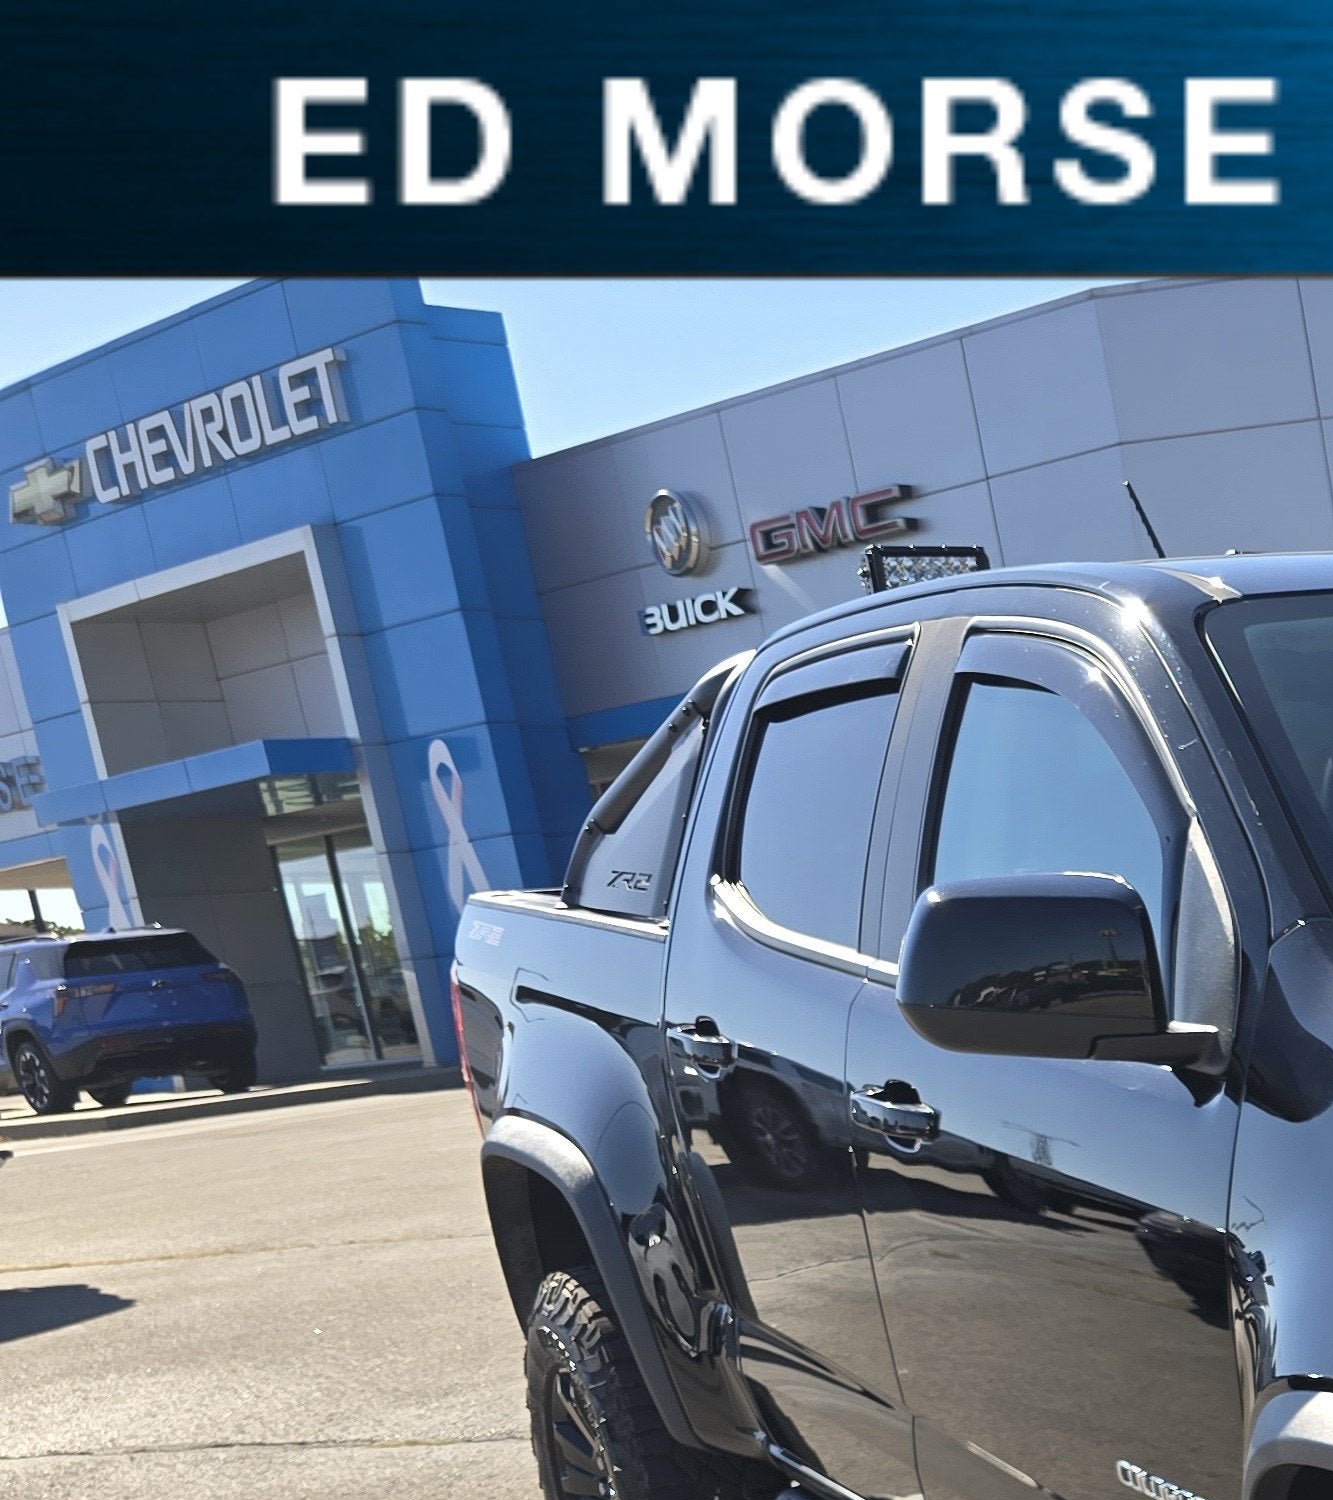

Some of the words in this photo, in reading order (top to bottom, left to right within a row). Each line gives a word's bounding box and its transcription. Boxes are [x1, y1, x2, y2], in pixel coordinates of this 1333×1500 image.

[85, 346, 342, 504] CHEVROLET
[750, 483, 912, 564] GMC
[642, 586, 748, 636] BUICK
[606, 869, 653, 892] ZR2
